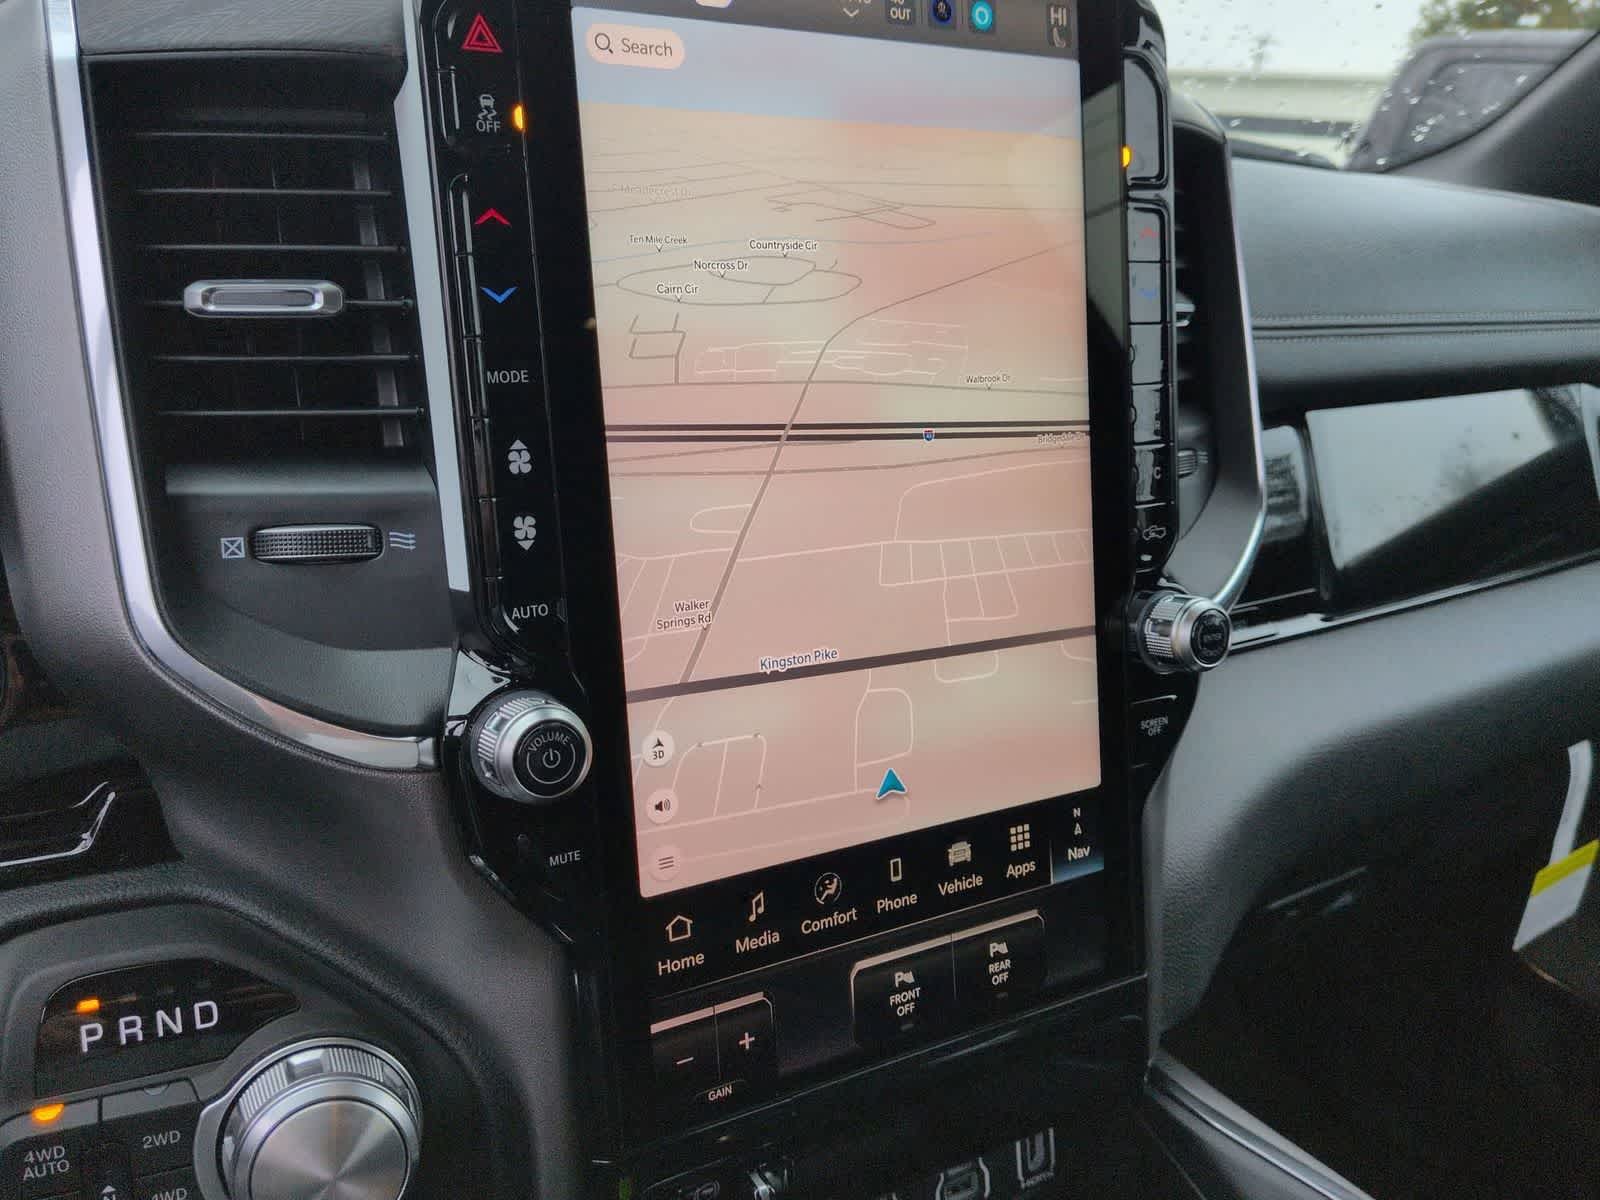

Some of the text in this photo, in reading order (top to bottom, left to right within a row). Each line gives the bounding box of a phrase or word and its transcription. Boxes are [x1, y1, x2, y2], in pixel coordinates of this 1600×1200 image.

[890, 7, 912, 21] OUT
[621, 38, 674, 58] Search
[475, 119, 501, 133] OFF
[629, 234, 644, 243] Ten
[664, 235, 688, 245] Creek
[749, 239, 804, 251] Countryside
[693, 260, 748, 271] Norcross Dr
[656, 283, 699, 295] Cairn Cir
[486, 369, 530, 385] MODE
[511, 603, 549, 620] AUTO
[674, 600, 710, 613] Walker
[656, 613, 712, 630] Springs Rd
[759, 649, 838, 671] Kingston Pike
[527, 731, 571, 752] VOLUME
[549, 850, 581, 867] MUTE
[1067, 846, 1091, 861] Nav
[1006, 860, 1036, 879] Apps
[938, 874, 984, 897] Vehicle
[876, 893, 918, 914] Phone
[801, 907, 858, 935] Comfort
[735, 930, 780, 954] Media
[658, 953, 705, 977] Home
[988, 959, 1012, 975] REAR
[991, 972, 1009, 986] OFF
[889, 987, 921, 1007] FRONT
[896, 1003, 916, 1017] OFF
[707, 1084, 733, 1102] GAIN
[142, 1130, 181, 1149] 2WD
[24, 1145, 66, 1164] 4WD
[23, 1159, 70, 1182] AUTO
